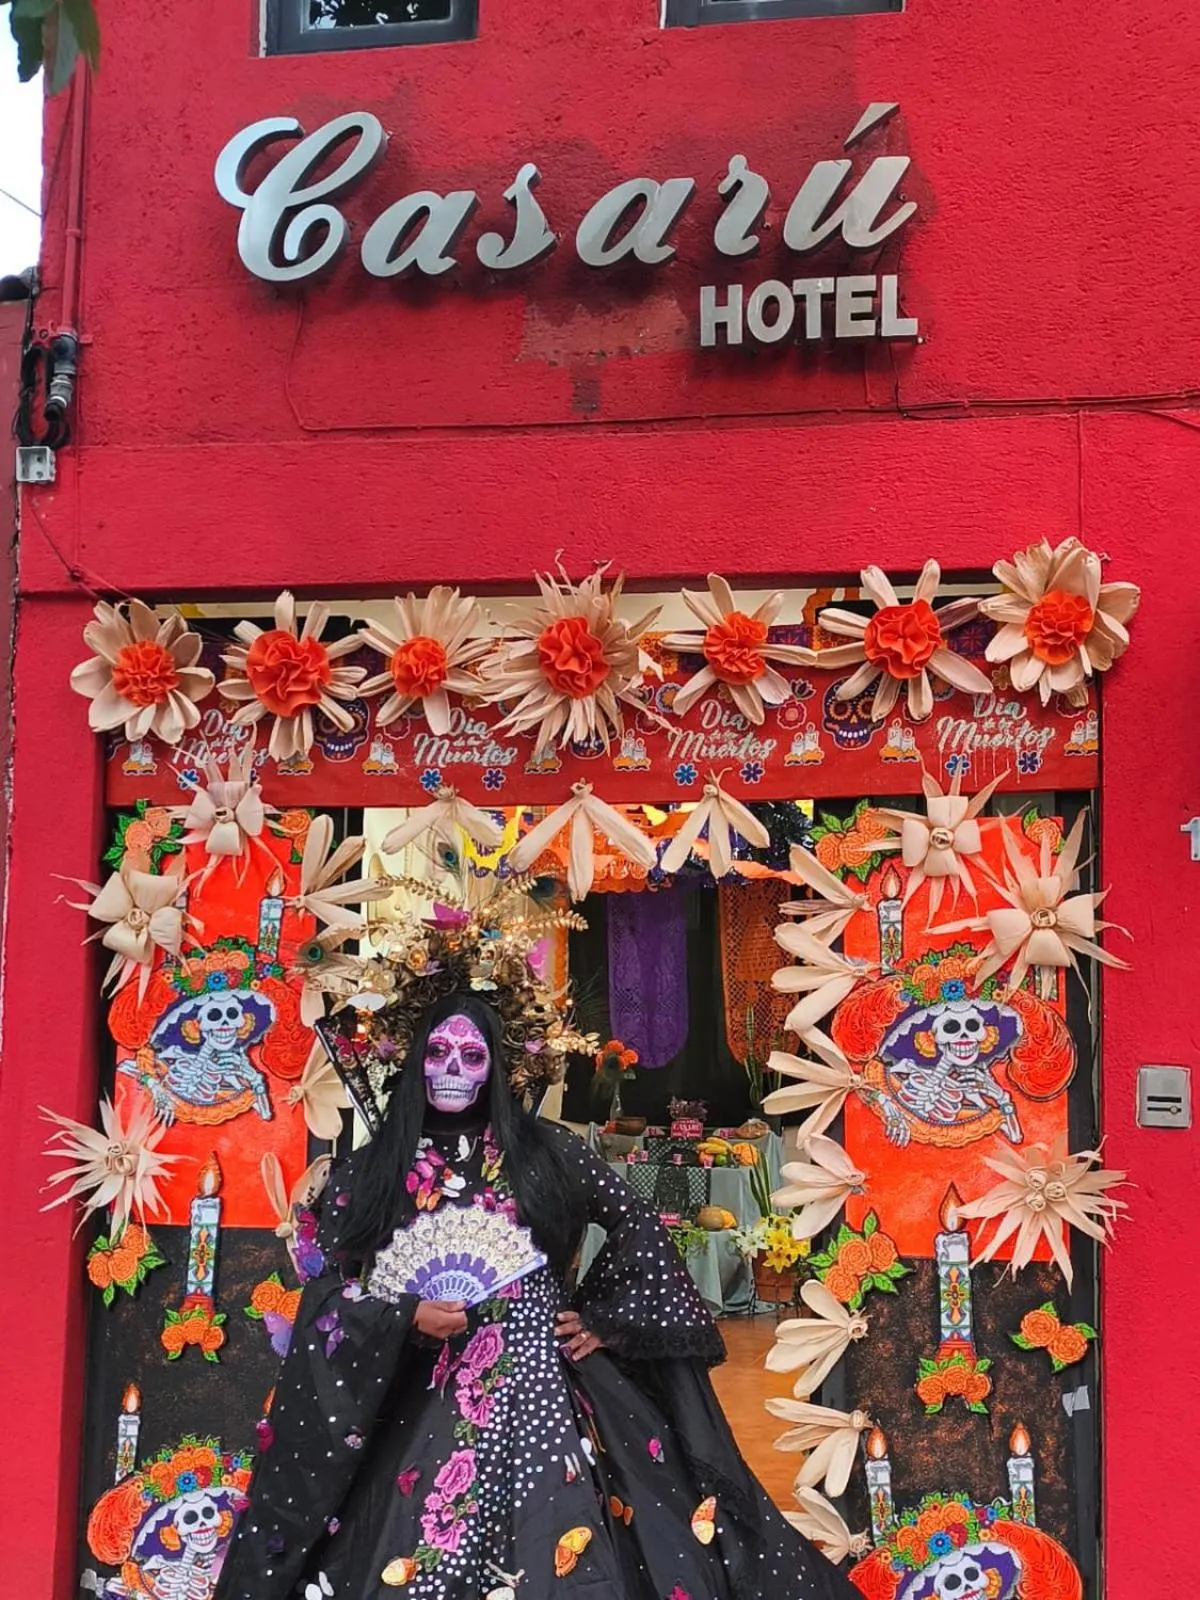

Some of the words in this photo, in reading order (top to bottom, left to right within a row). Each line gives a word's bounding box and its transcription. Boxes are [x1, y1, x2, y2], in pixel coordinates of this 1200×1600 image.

[214, 102, 918, 282] Casarú
[700, 274, 919, 347] HOTEL
[413, 732, 518, 768] Muertos
[667, 726, 777, 763] Muertos
[936, 716, 1056, 753] Muertos
